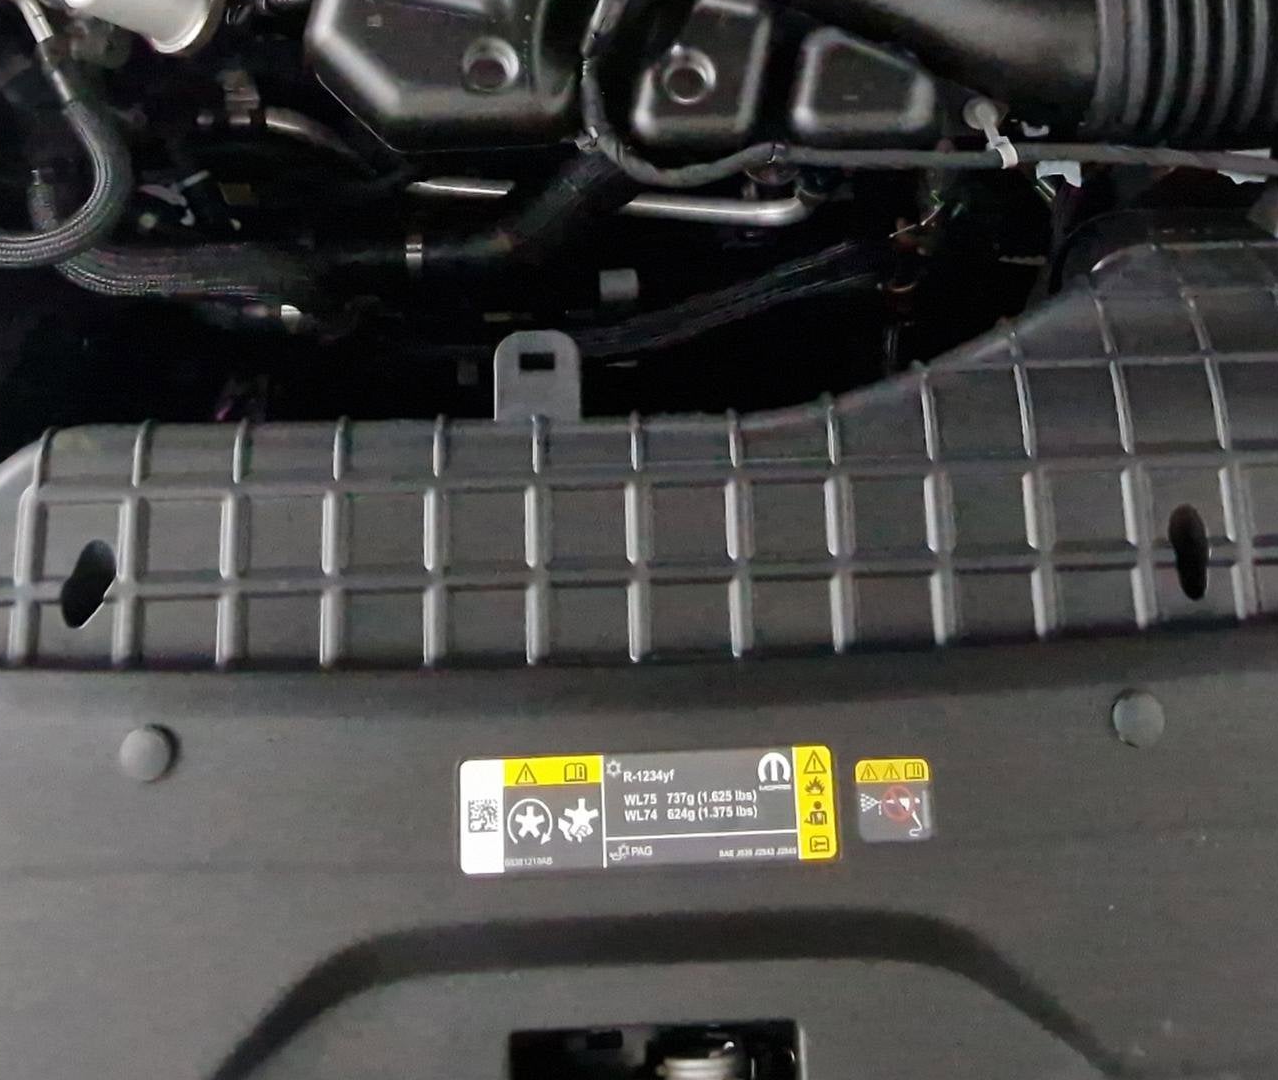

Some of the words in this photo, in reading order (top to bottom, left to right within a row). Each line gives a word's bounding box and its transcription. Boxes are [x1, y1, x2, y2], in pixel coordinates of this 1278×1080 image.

[623, 768, 675, 784] R-1234yf
[624, 792, 657, 807] WL75
[666, 791, 695, 806] 737g
[698, 789, 733, 805] (1.625
[735, 789, 757, 804] lbs)
[625, 808, 658, 822] WL74
[667, 807, 696, 822] 624g
[698, 805, 734, 821] (1.375
[736, 804, 758, 819] lbs)
[631, 845, 653, 857] PAG
